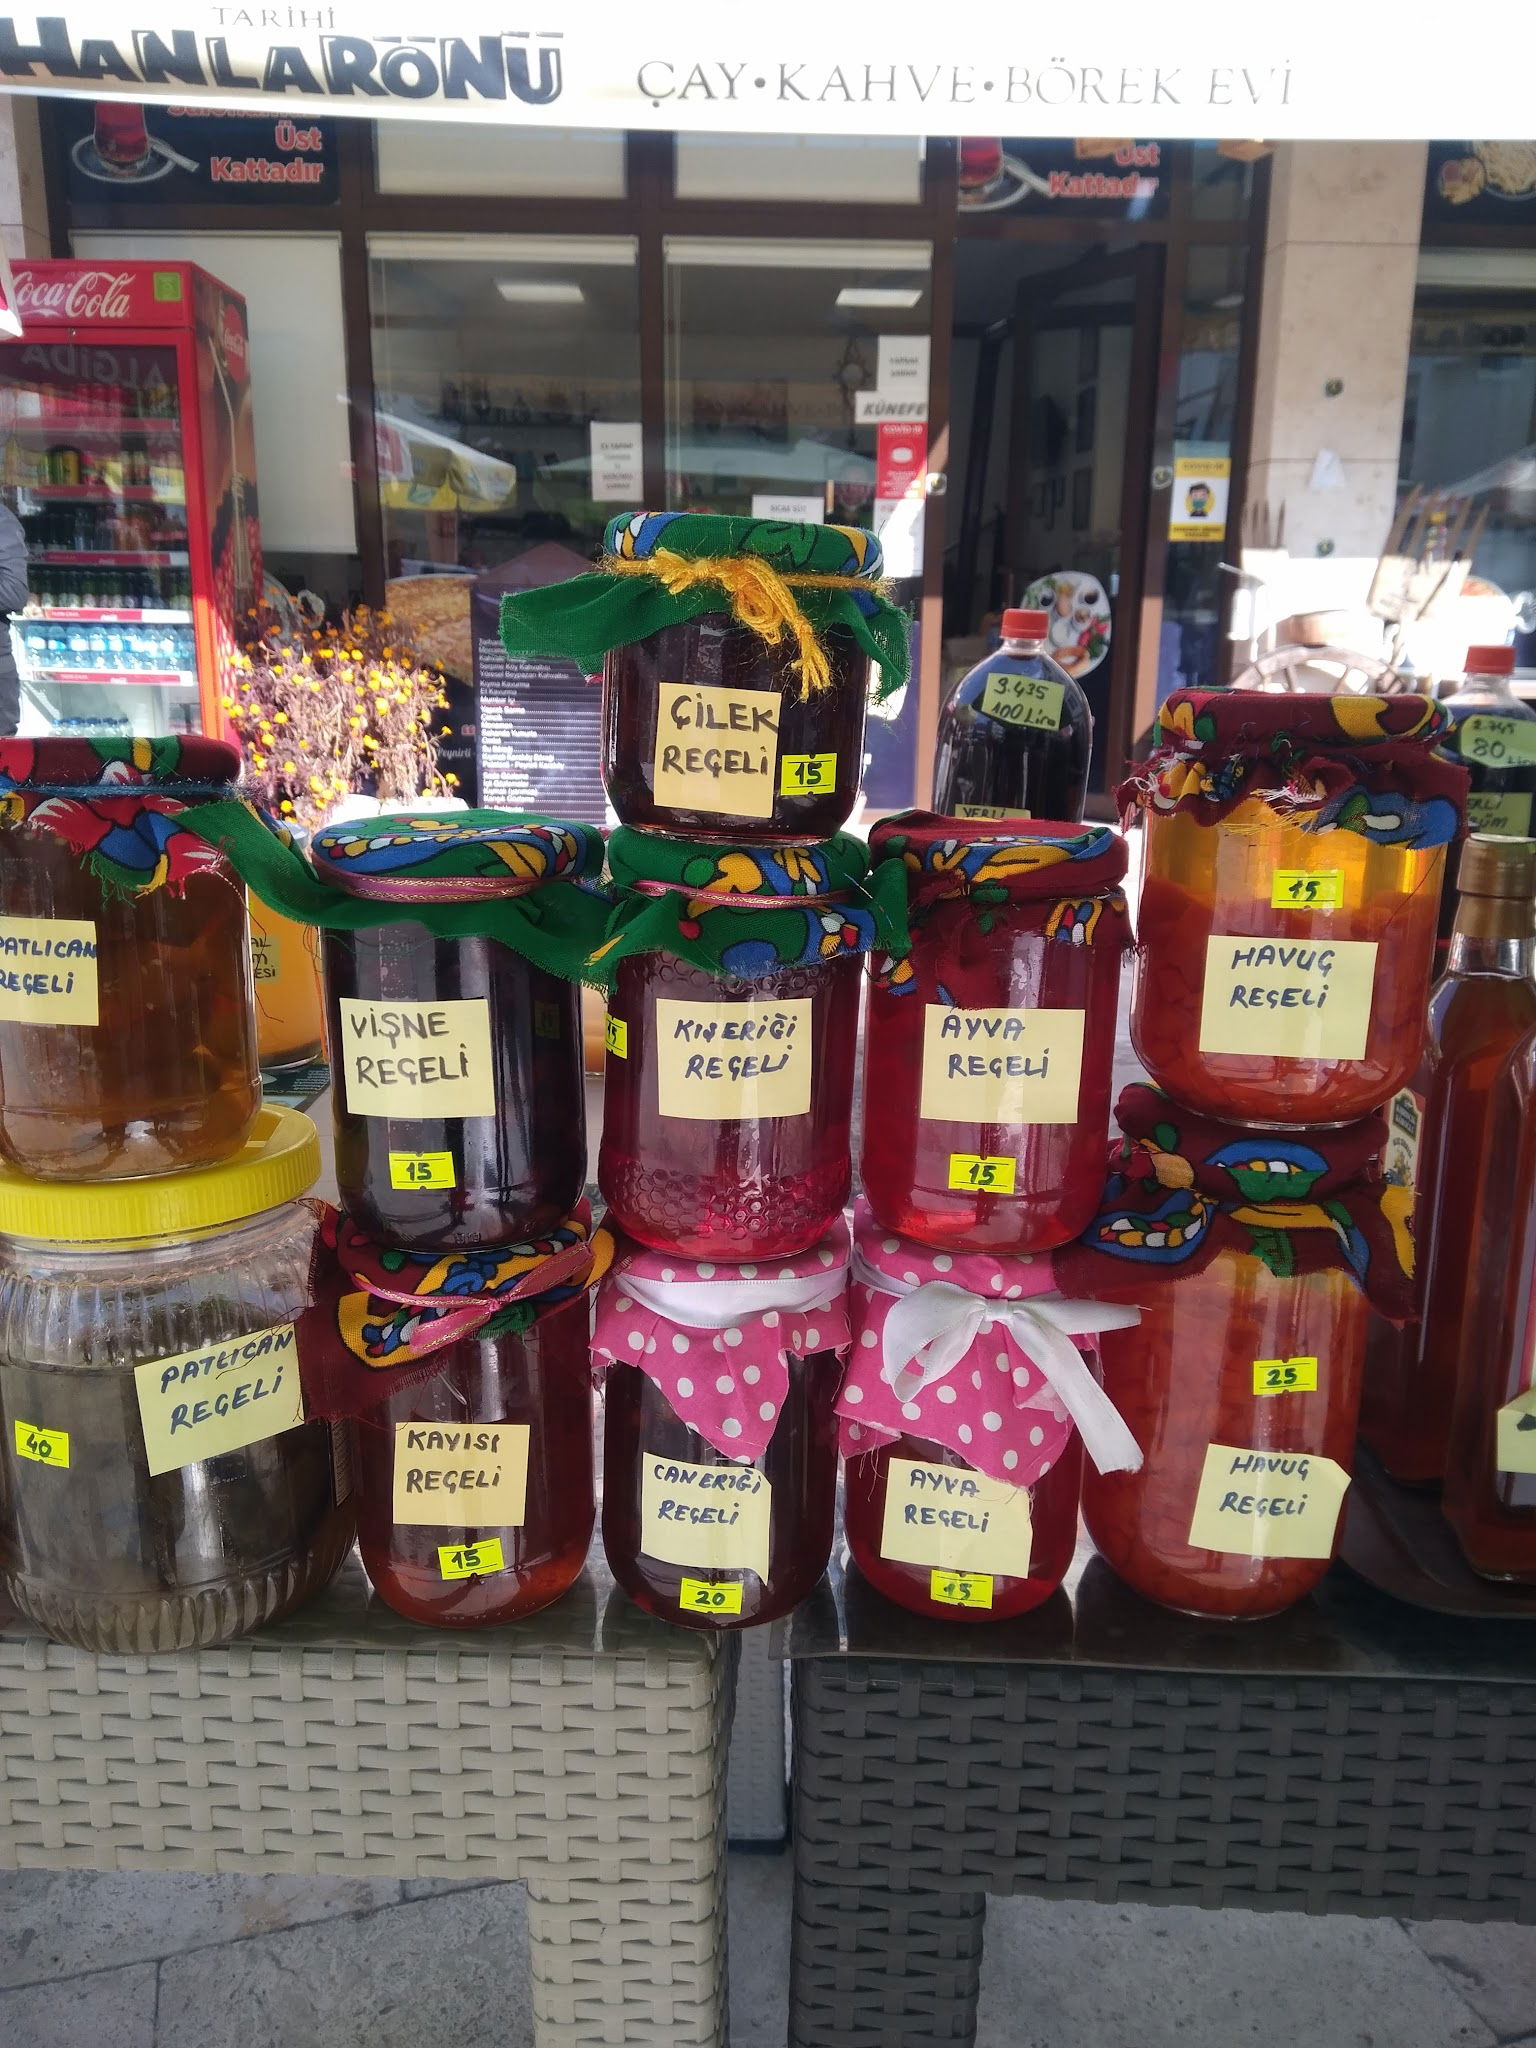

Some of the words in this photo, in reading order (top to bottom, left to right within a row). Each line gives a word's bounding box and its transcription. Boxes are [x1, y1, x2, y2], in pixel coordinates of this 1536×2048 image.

[211, 6, 336, 30] TARİHİ
[637, 60, 748, 108] ÇAY
[776, 63, 976, 103] KAHVE
[1005, 56, 1182, 105] BÖREK
[1208, 59, 1292, 105] EVİ
[275, 120, 323, 151] Üst
[210, 156, 324, 183] Kattadır
[863, 400, 927, 416] KÜNEFE
[670, 692, 778, 735] ÇİLEK
[992, 701, 1024, 720] 100
[1472, 737, 1506, 759] 80
[661, 745, 769, 779] REÇELİ
[794, 762, 822, 785] 15
[1288, 879, 1321, 901] 15
[1231, 945, 1336, 977] HAVUÇ
[1229, 985, 1330, 1009] REÇELİ
[350, 1007, 451, 1050] VİŞNE
[941, 1014, 1026, 1042] AYVA
[356, 1042, 469, 1089] REÇELİ
[684, 1045, 793, 1081] REÇELİ
[947, 1048, 1050, 1079] REÇELİ
[405, 1162, 433, 1181] 15
[968, 1163, 998, 1186] 15
[160, 1331, 294, 1394] PATLICAN
[1266, 1367, 1298, 1386] 25
[169, 1366, 284, 1435] REÇELİ
[26, 1433, 53, 1458] 40
[407, 1429, 501, 1453] KAYISI
[406, 1465, 501, 1494] REÇELİ
[1229, 1454, 1310, 1481] HAVUÇ
[910, 1468, 980, 1498] AYVA
[658, 1500, 740, 1526] REÇELİ
[904, 1503, 990, 1533] REÇELİ
[1219, 1491, 1309, 1518] REÇELİ
[451, 1549, 481, 1570] 15
[694, 1590, 726, 1606] 20
[943, 1582, 973, 1601] 15
